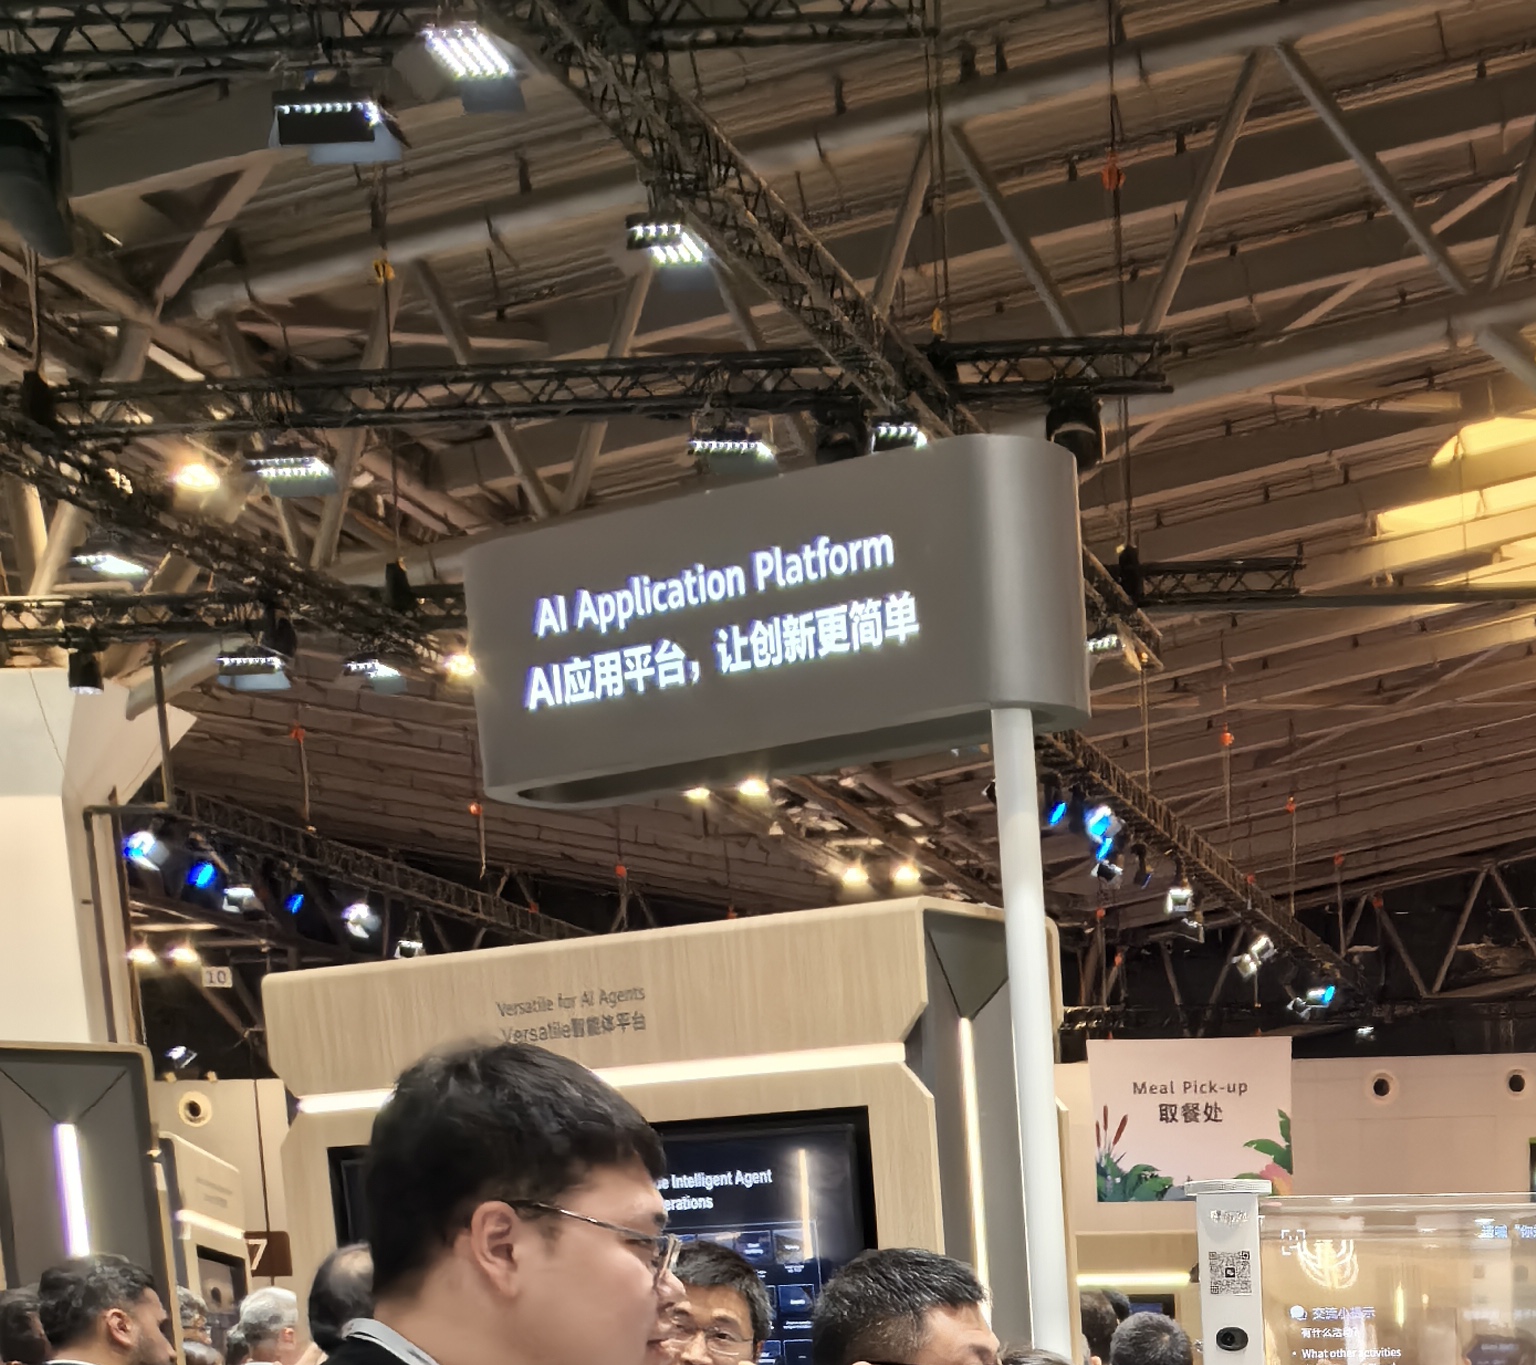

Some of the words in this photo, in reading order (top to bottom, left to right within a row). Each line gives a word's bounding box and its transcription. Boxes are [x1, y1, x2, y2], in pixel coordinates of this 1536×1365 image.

[534, 595, 569, 637] AI
[572, 563, 746, 633] Application
[752, 533, 895, 592] Platform
[524, 590, 920, 711] AI应用平台，让创新更简单
[206, 970, 226, 984] 10
[495, 996, 554, 1017] Versatile
[558, 993, 577, 1009] for
[599, 987, 646, 1009] Agents
[1132, 1080, 1175, 1094] Meal
[1182, 1080, 1248, 1096] Pick-up
[1158, 1100, 1223, 1123] 取餐处
[671, 1171, 733, 1190] Intelligent
[735, 1169, 773, 1188] Agent
[662, 1194, 714, 1211] erations
[1302, 1348, 1328, 1359] What
